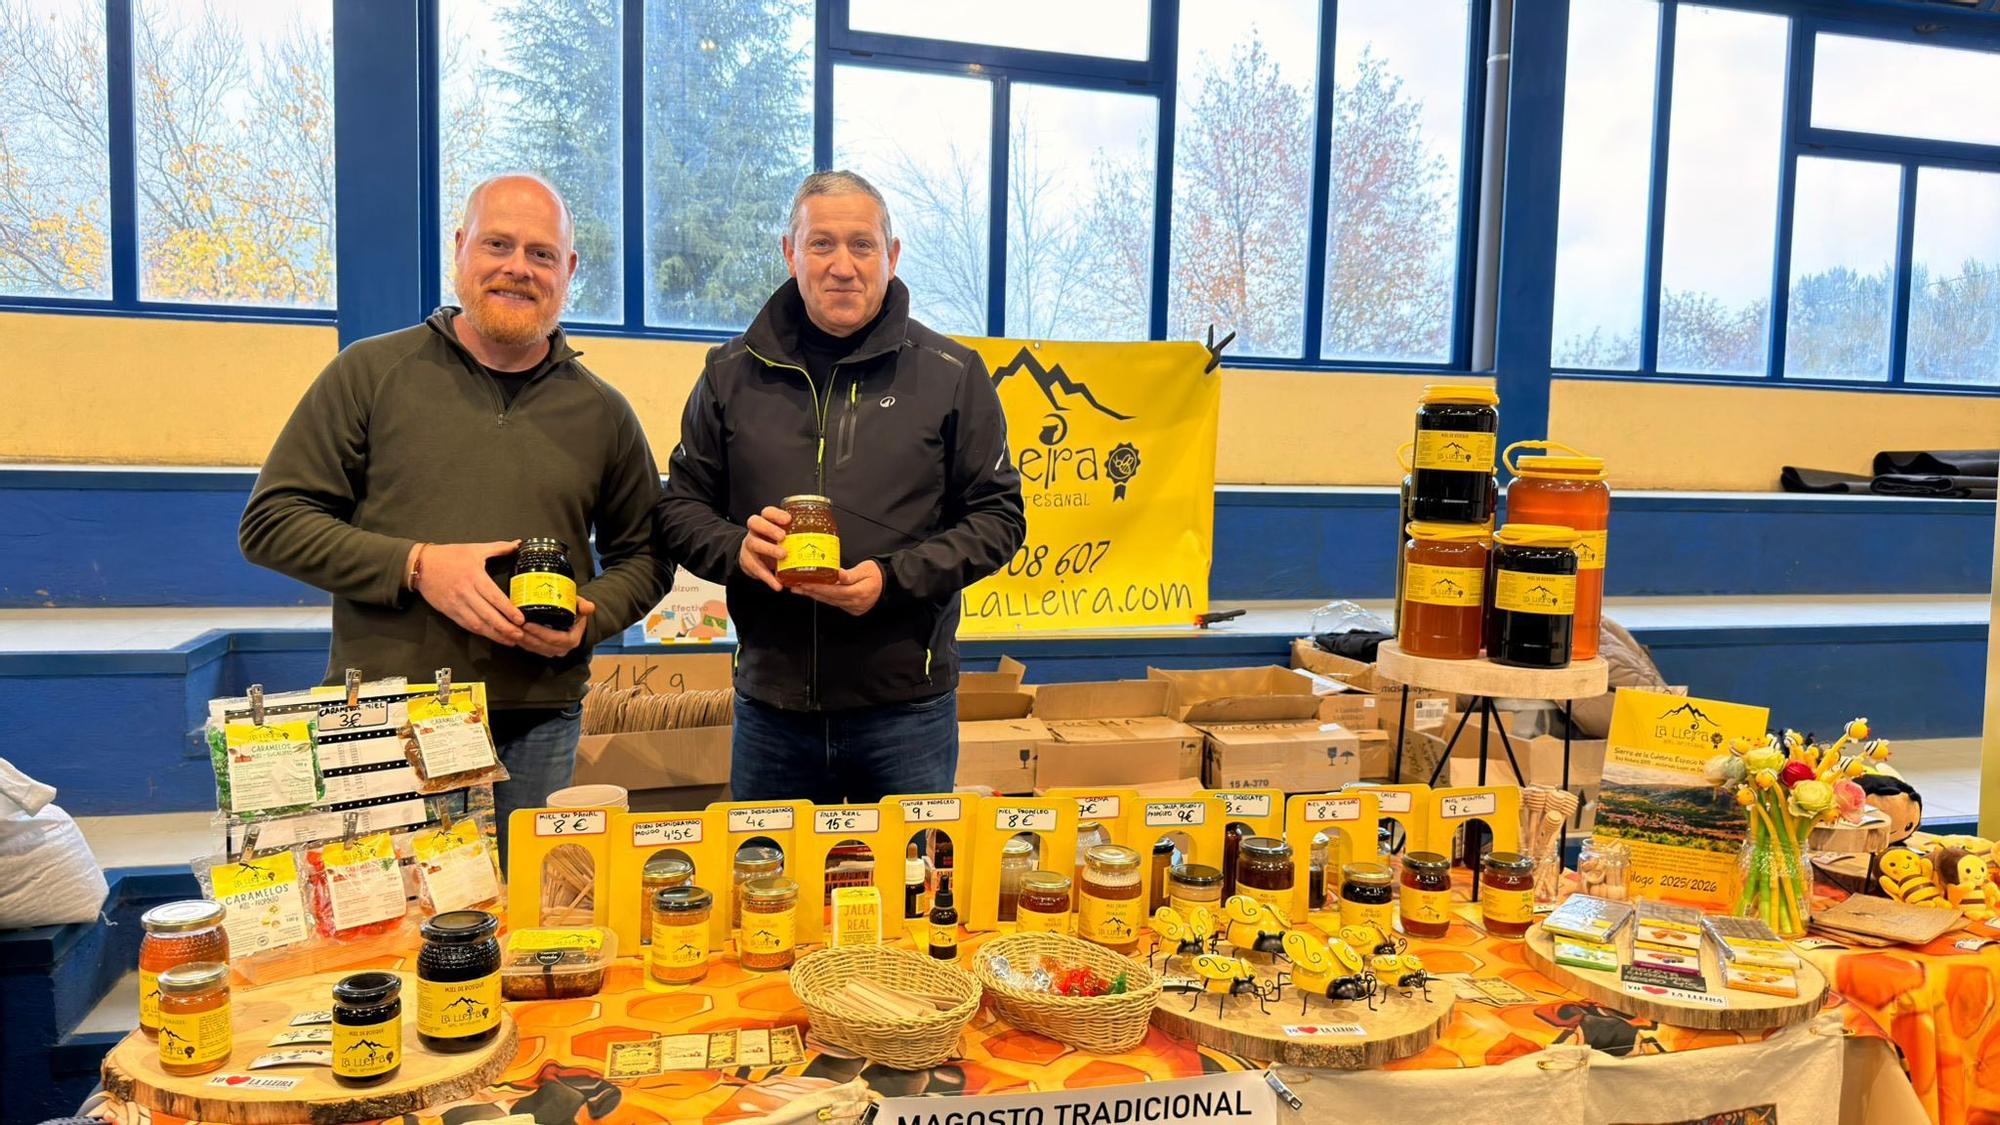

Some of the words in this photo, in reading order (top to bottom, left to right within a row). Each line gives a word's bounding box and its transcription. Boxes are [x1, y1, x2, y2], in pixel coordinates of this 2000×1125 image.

[1018, 435, 1098, 490] eira
[990, 544, 1049, 578] 08
[1055, 540, 1111, 576] 607
[672, 585, 700, 593] izum
[671, 604, 708, 612] Efectivo
[251, 743, 292, 753] CARAMELOS
[1243, 779, 1269, 788] A-370
[554, 819, 566, 834] 8
[572, 818, 588, 832] €
[1632, 871, 1655, 888] logo
[1660, 874, 1718, 893] 2025/2026
[225, 883, 289, 906] CARAMELOS
[843, 904, 876, 917] JALEA
[847, 919, 870, 931] REAL
[212, 1076, 225, 1084] YO
[1054, 1090, 1252, 1125] TRADICIONAL
